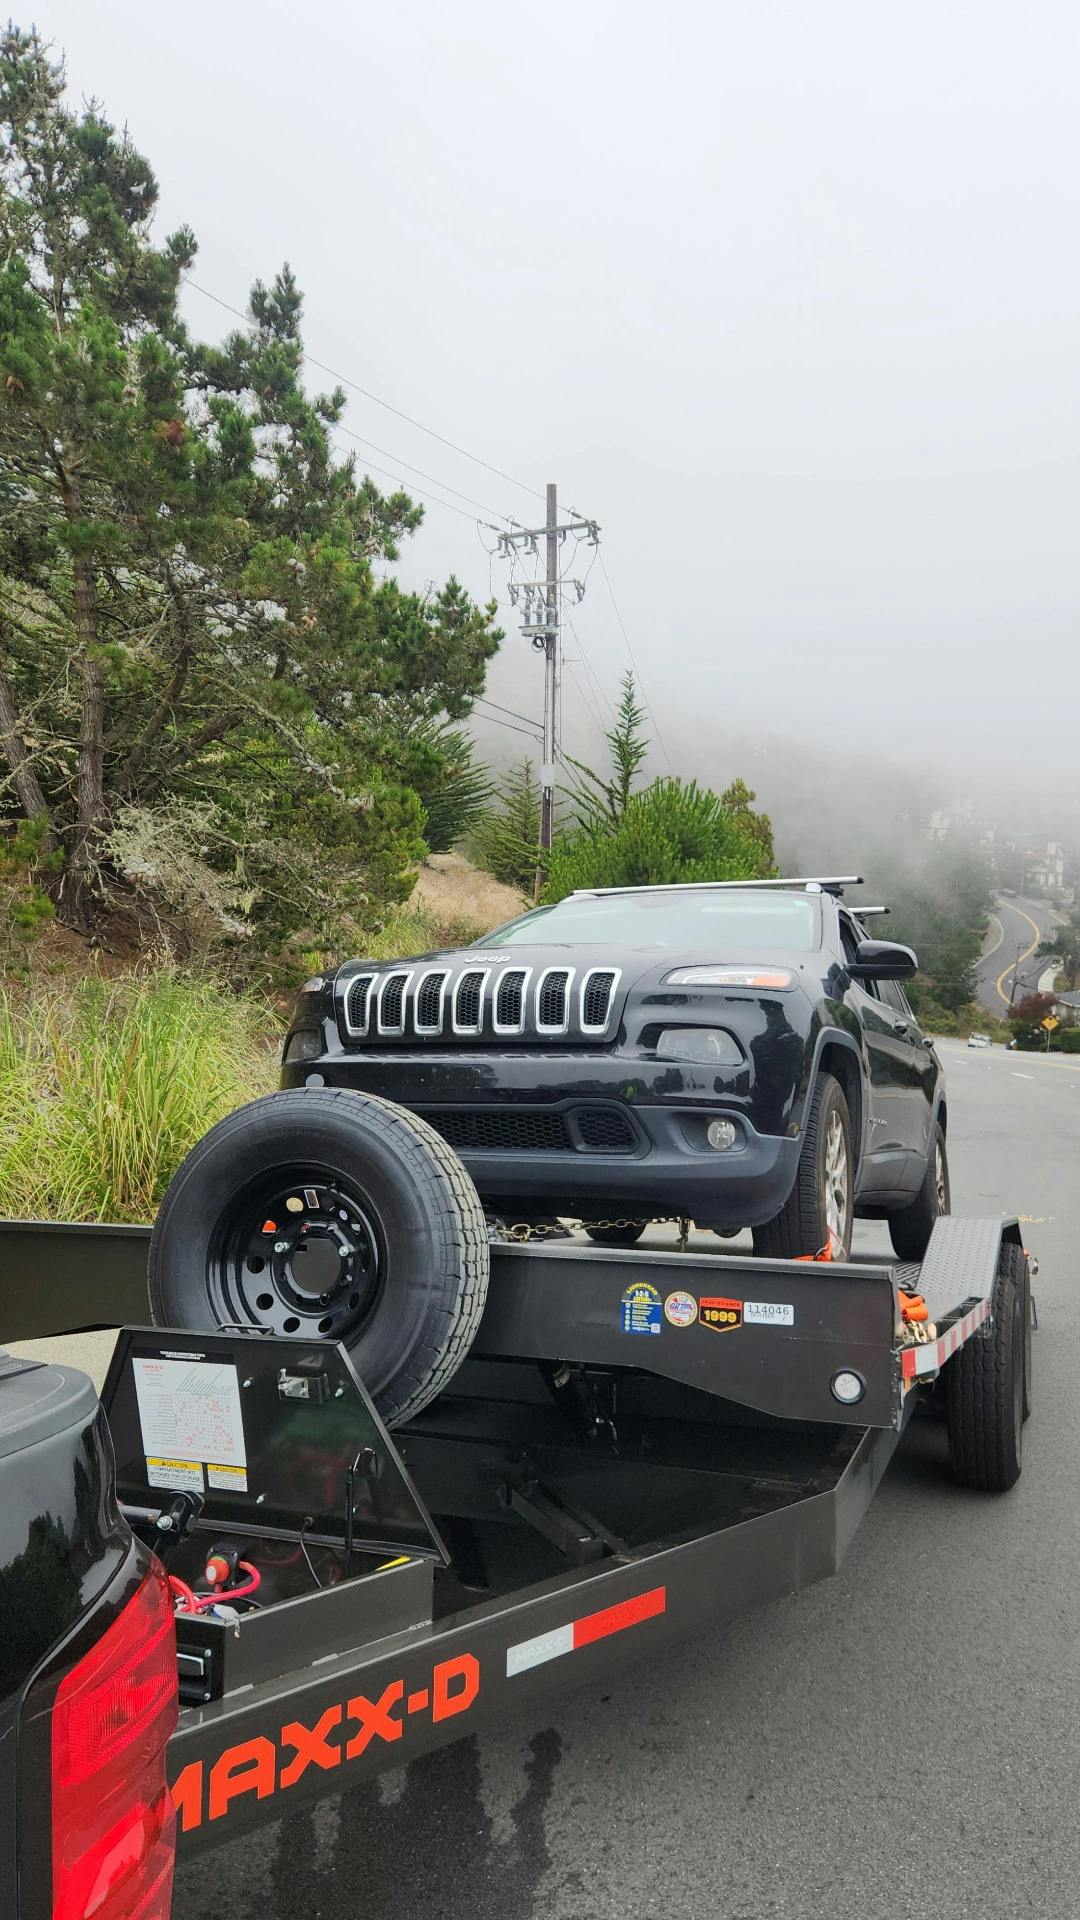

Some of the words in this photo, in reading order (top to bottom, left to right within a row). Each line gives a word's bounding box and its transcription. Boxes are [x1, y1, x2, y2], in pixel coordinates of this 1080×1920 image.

[464, 955, 511, 964] Jeep
[704, 1309, 737, 1323] 1999
[748, 1305, 789, 1316] 114046
[515, 1635, 565, 1665] MAXX-D
